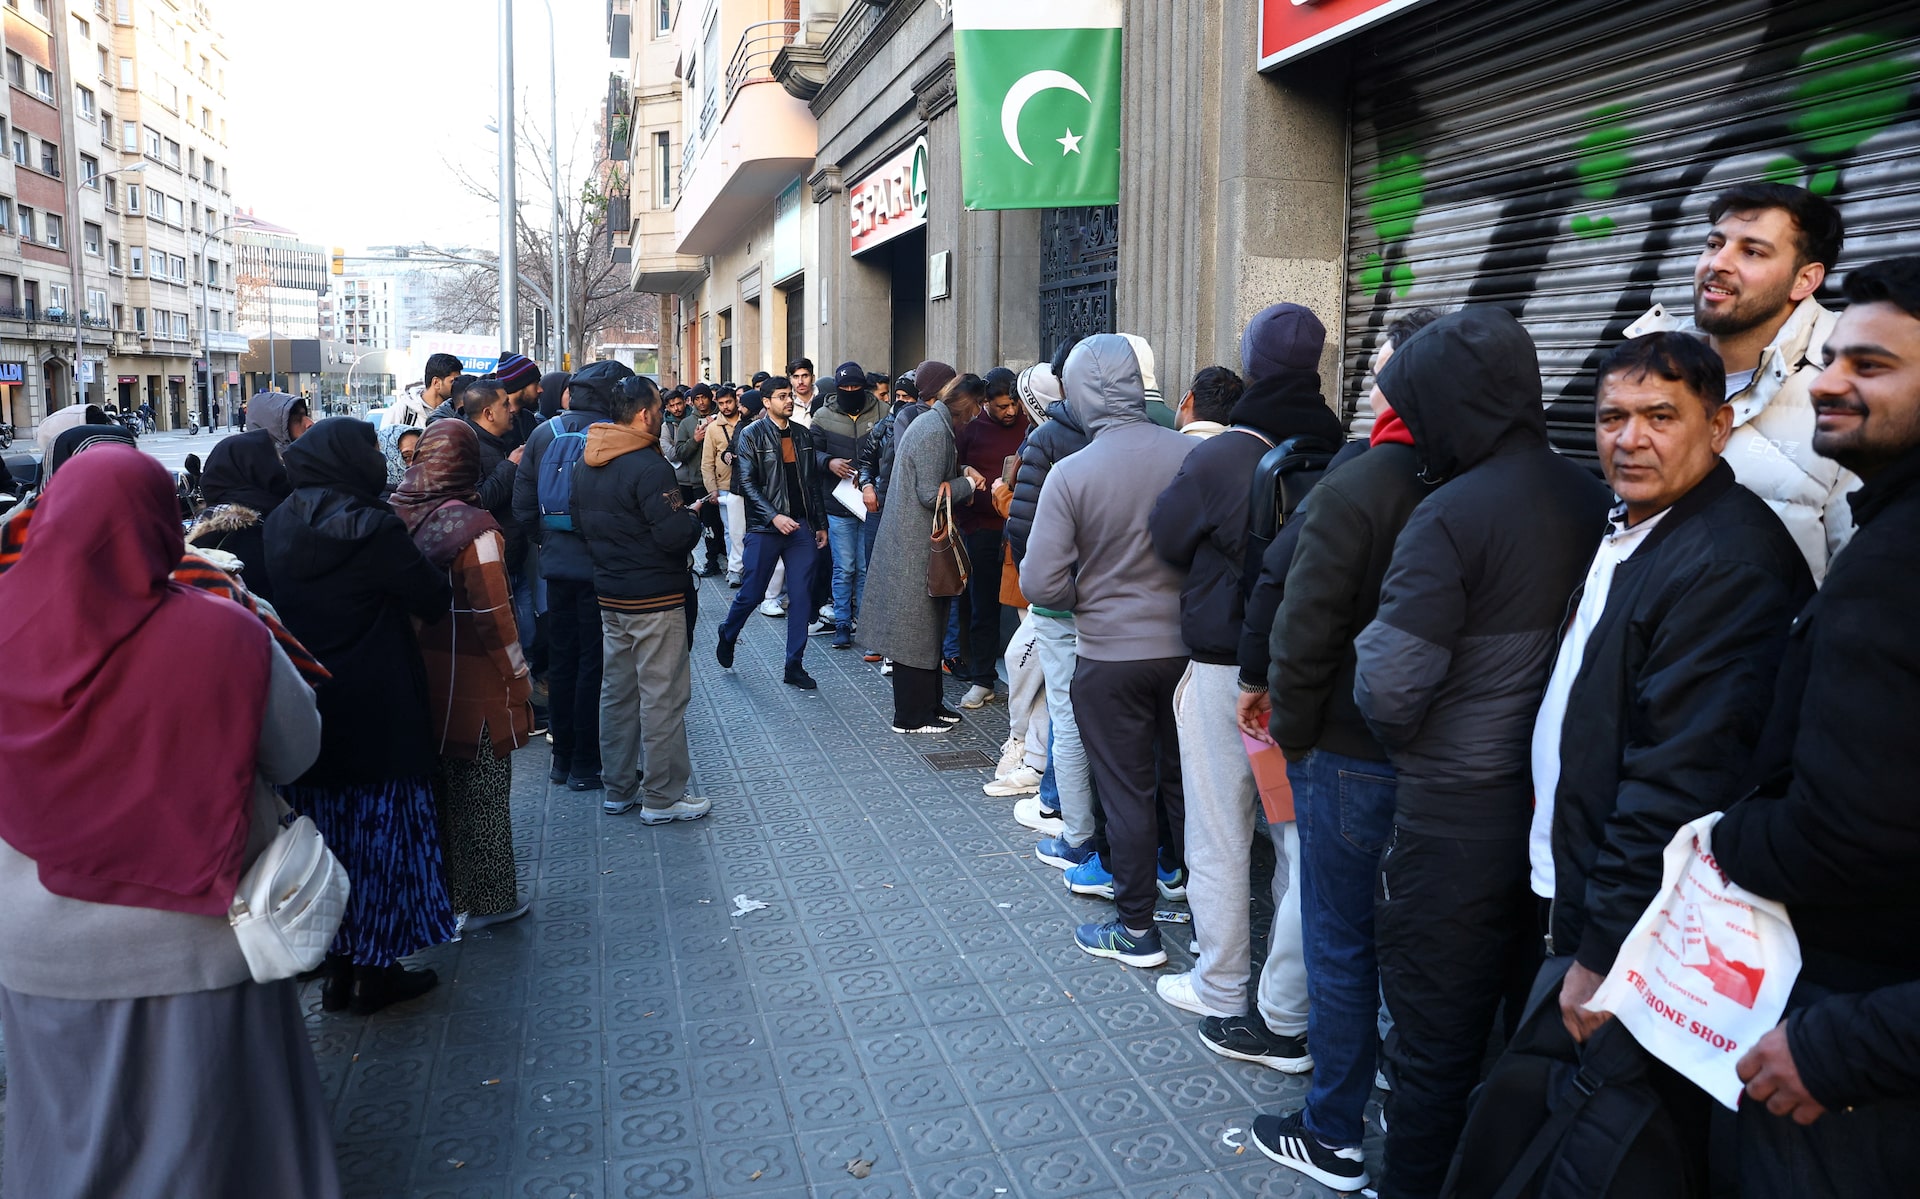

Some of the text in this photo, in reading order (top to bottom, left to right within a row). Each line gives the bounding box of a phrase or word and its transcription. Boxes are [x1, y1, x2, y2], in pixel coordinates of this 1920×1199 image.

[851, 167, 908, 238] SPAR
[460, 358, 491, 370] uiler
[1626, 969, 1649, 995] THE
[1643, 987, 1688, 1029] PHONE
[1688, 1019, 1738, 1054] SHOP
